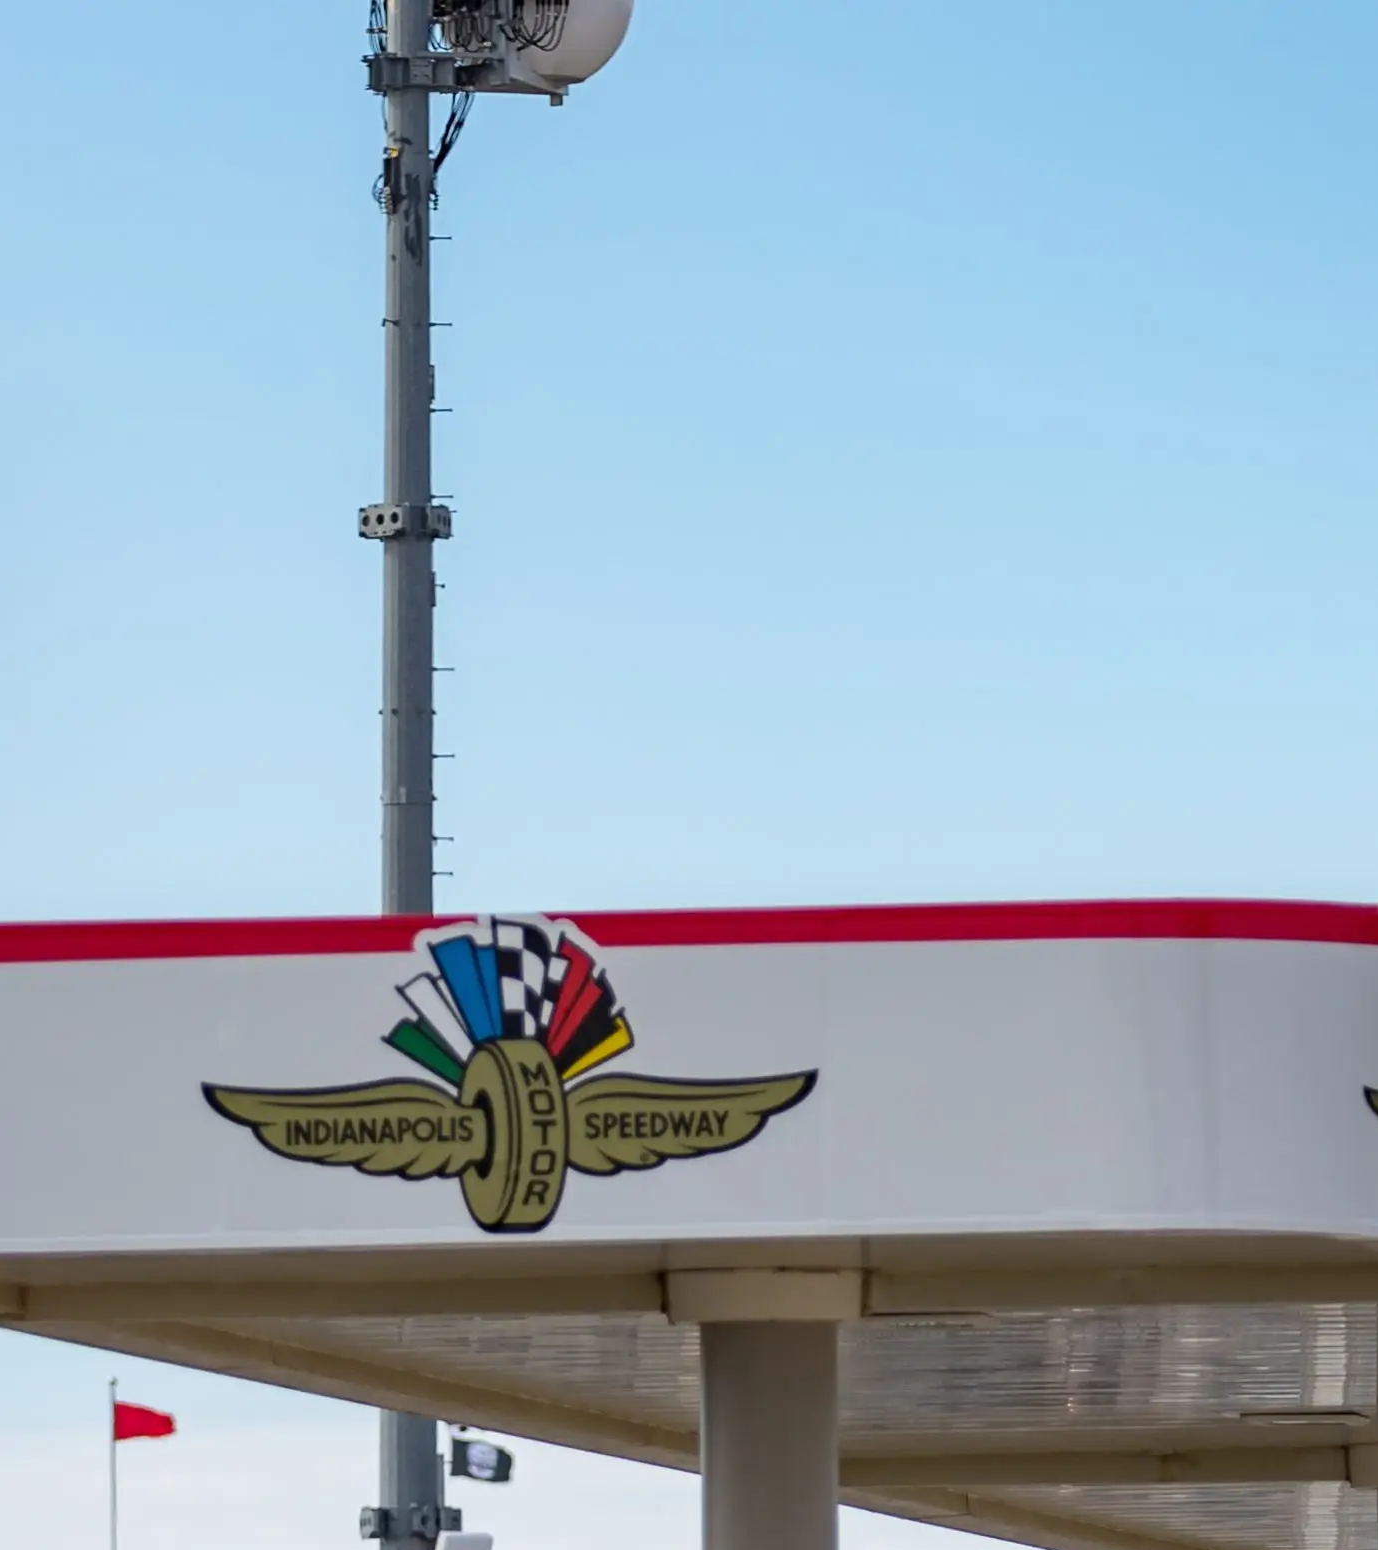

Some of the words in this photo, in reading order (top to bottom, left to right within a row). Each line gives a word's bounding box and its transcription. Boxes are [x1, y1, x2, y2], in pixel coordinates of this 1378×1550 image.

[285, 1115, 474, 1146] INDIANAPOLIS
[518, 1061, 557, 1206] MOTOR
[584, 1109, 730, 1140] SPEEDWAY
